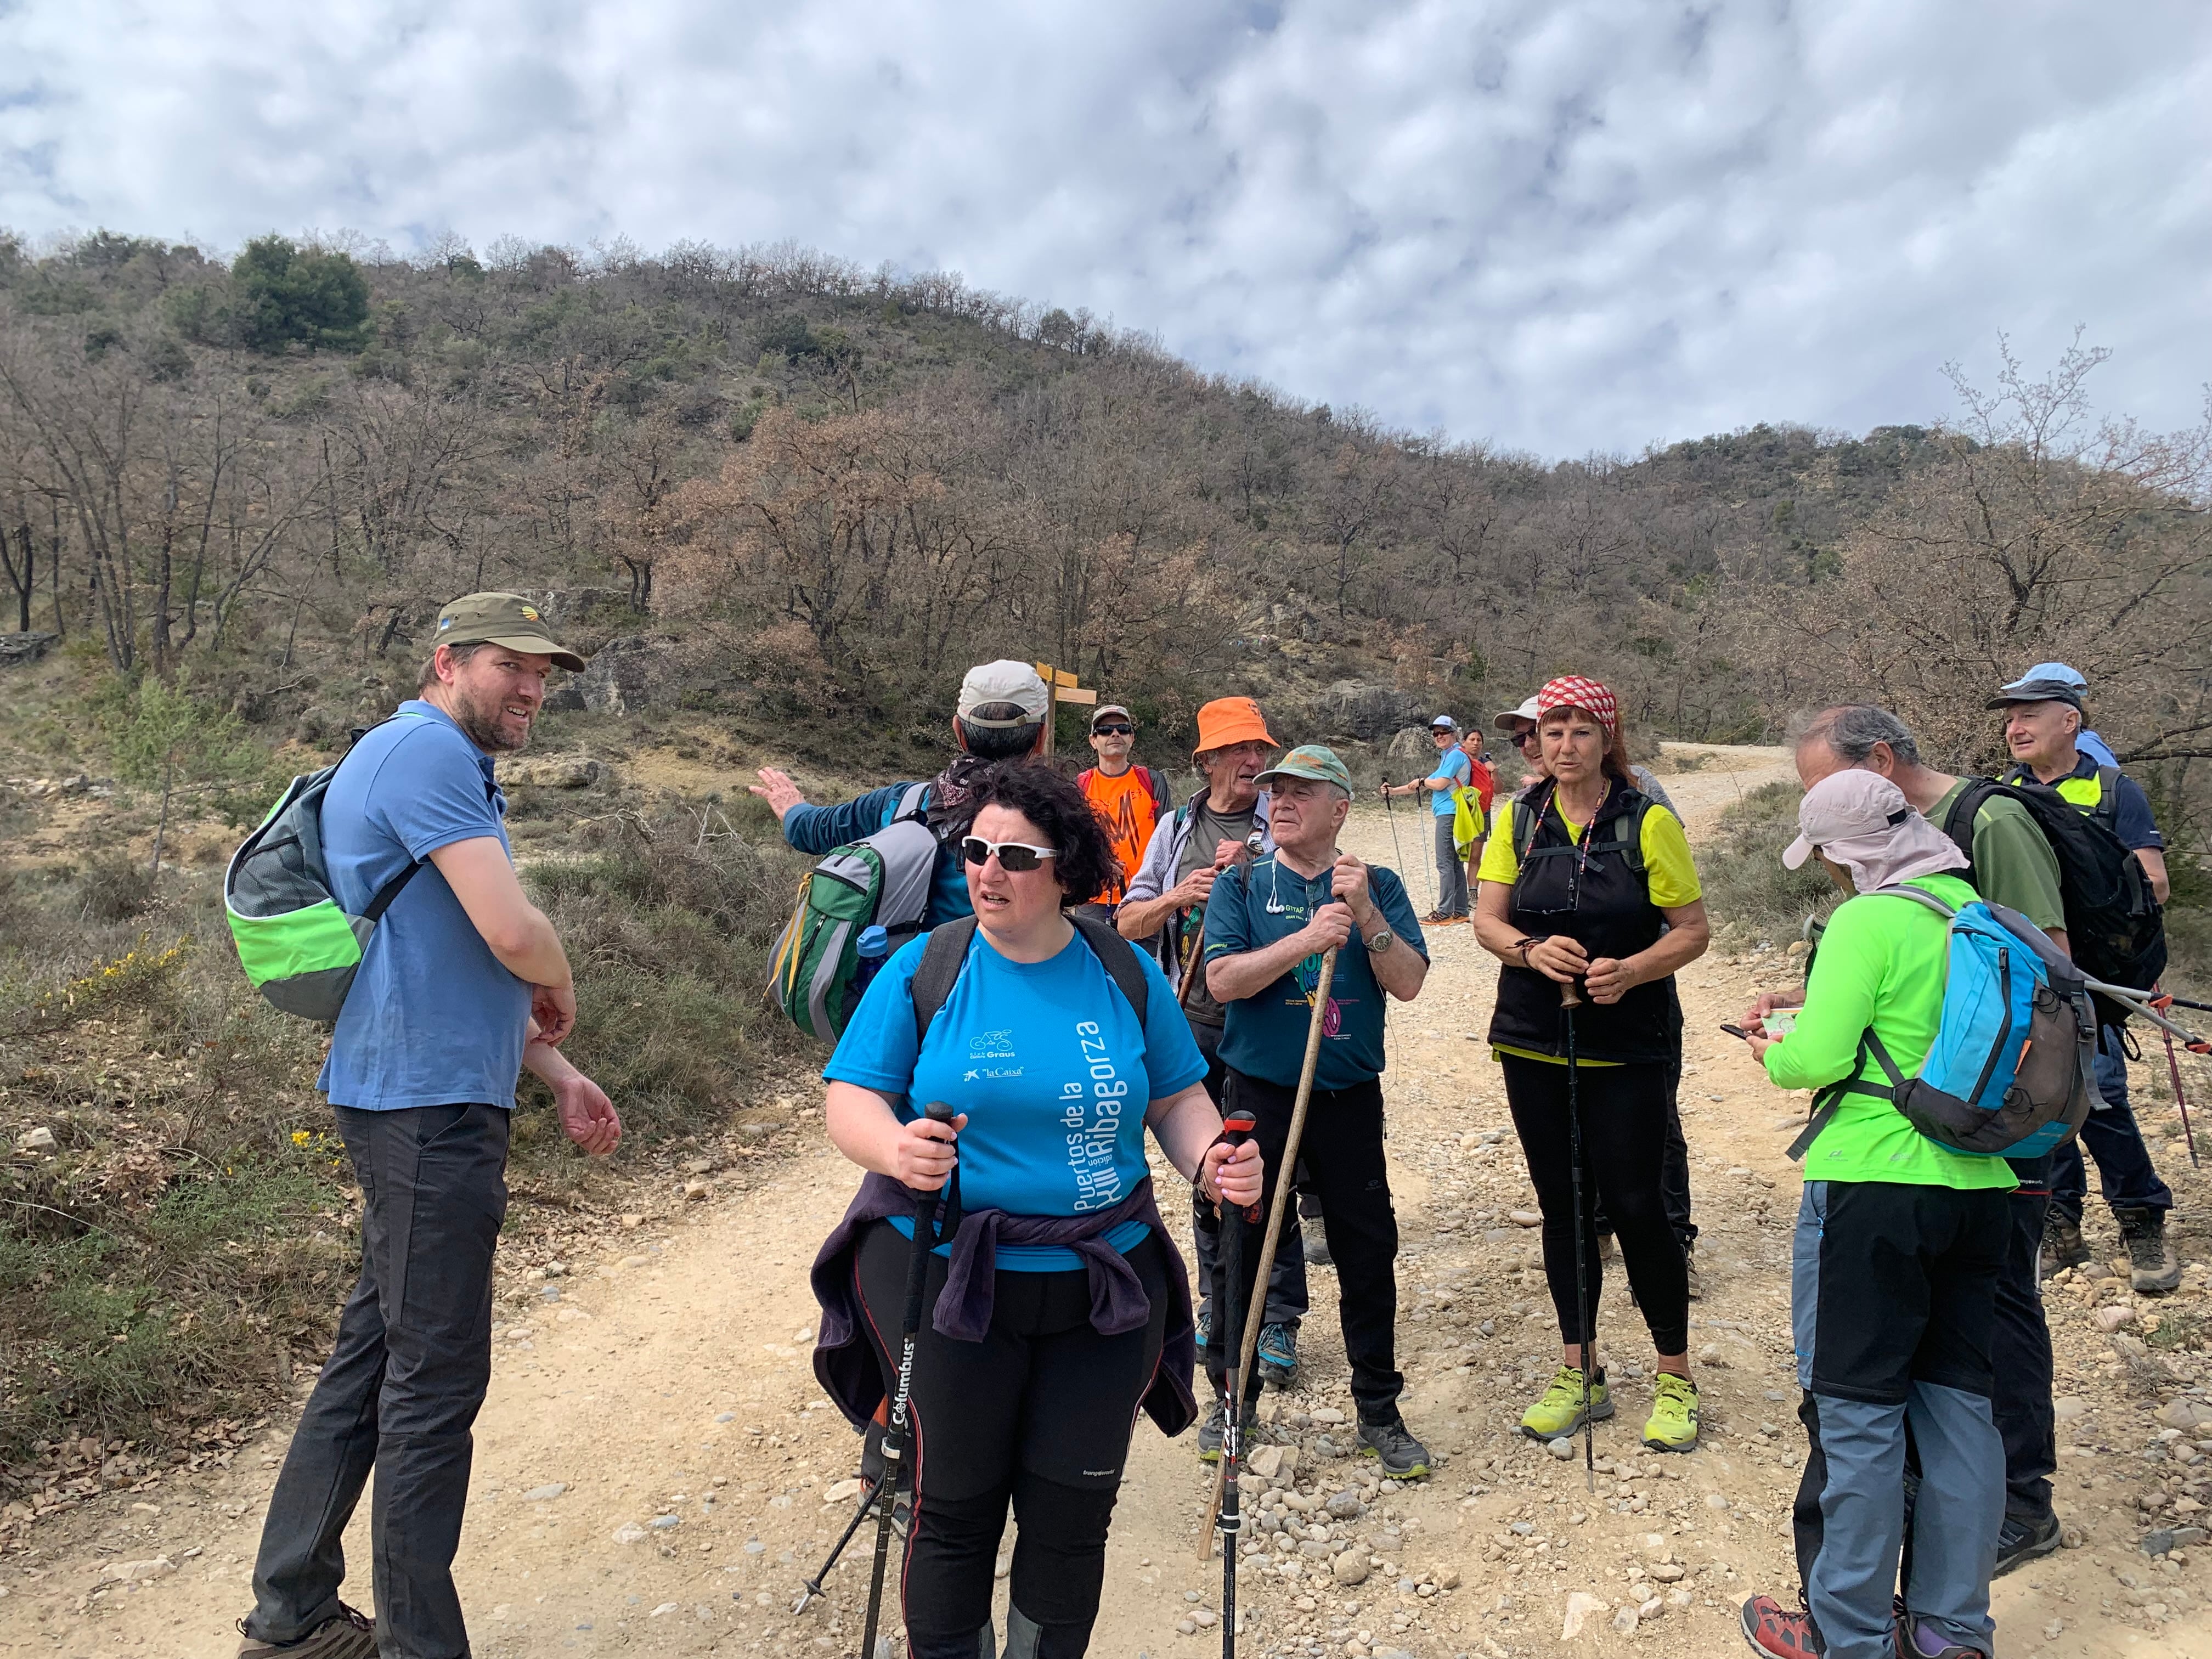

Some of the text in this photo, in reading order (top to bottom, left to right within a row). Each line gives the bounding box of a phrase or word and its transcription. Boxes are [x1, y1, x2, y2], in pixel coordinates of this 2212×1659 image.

[1058, 1082, 1096, 1211] Puertos de la
[1076, 1021, 1128, 1158] Ribagorza
[1087, 1154, 1113, 1167] edición
